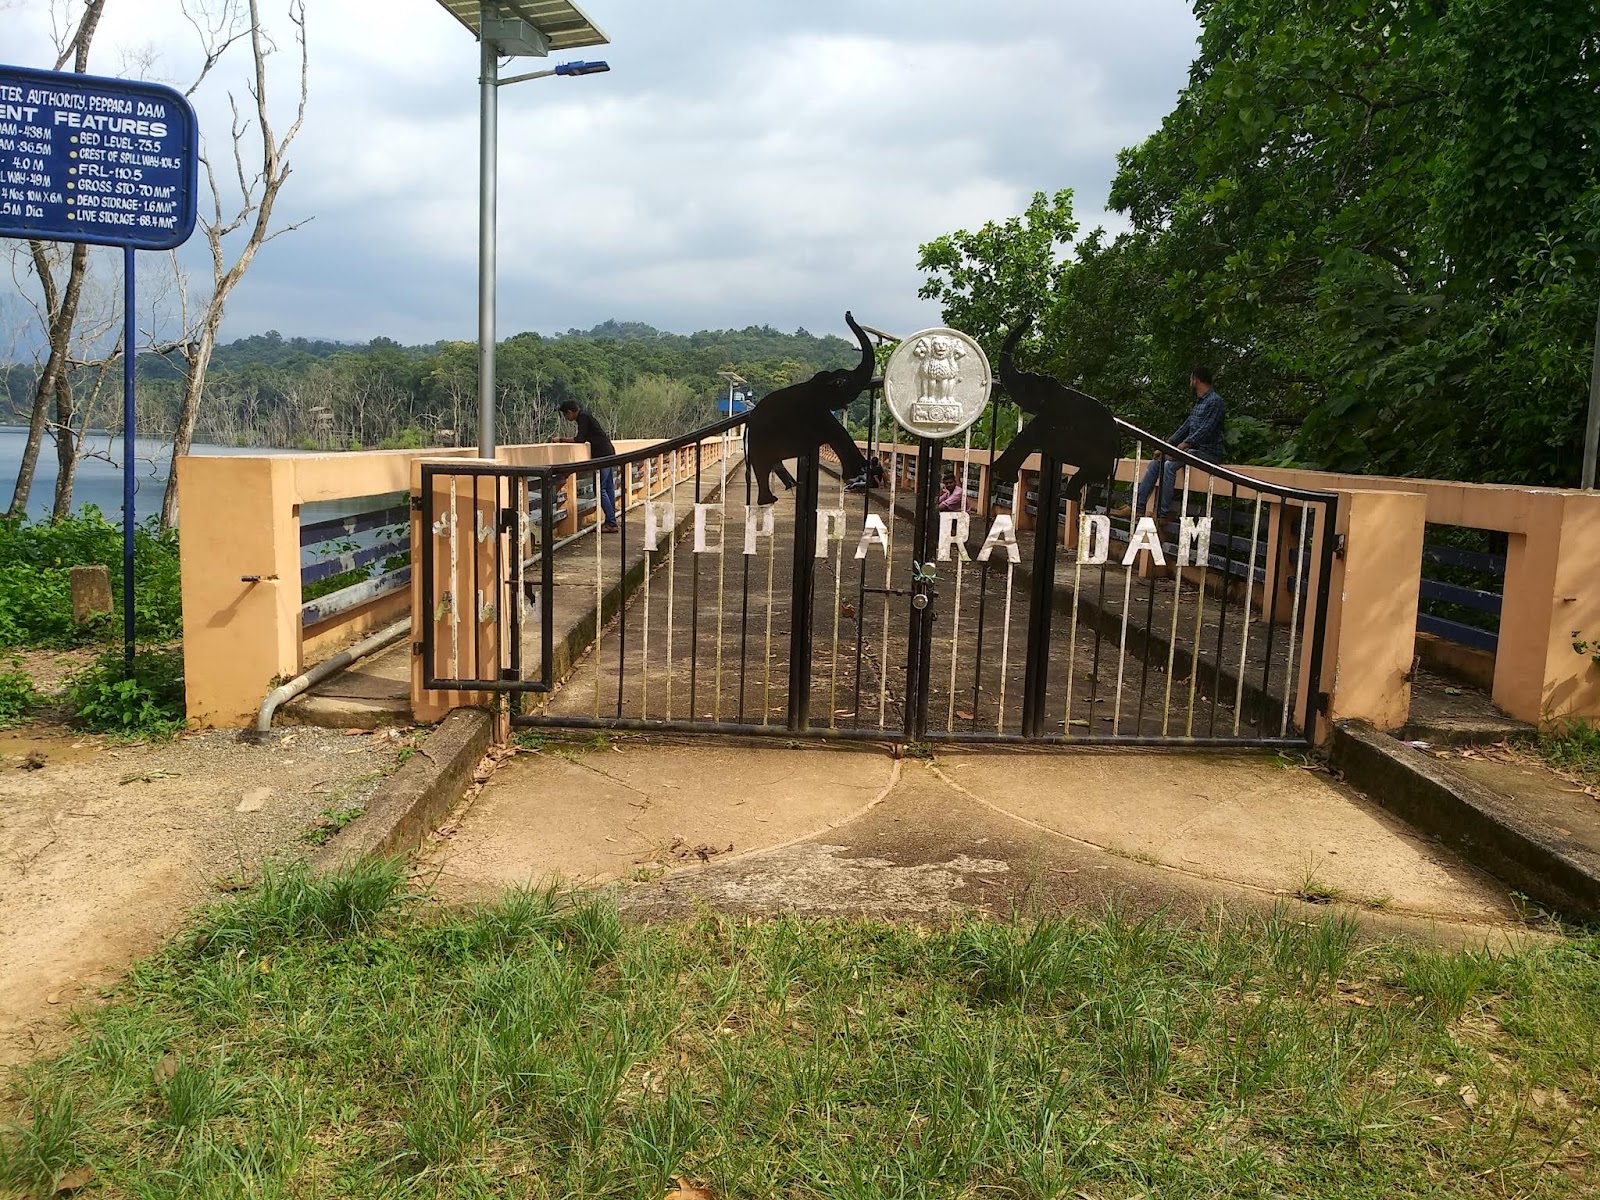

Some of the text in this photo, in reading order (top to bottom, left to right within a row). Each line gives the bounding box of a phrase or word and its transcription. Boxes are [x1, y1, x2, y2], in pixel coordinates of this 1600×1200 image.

[27, 89, 87, 111] AUTHORITY,
[89, 96, 133, 114] PEPPARA
[137, 101, 166, 119] DAM
[54, 111, 168, 137] FEATURES
[80, 132, 100, 145] BED
[80, 148, 106, 161] CREST
[107, 151, 119, 162] OF
[77, 178, 112, 193] GROSS
[77, 194, 100, 207] DEAD
[25, 204, 44, 218] Dia
[77, 209, 97, 222] LIVE
[1077, 514, 1214, 567] DAM
